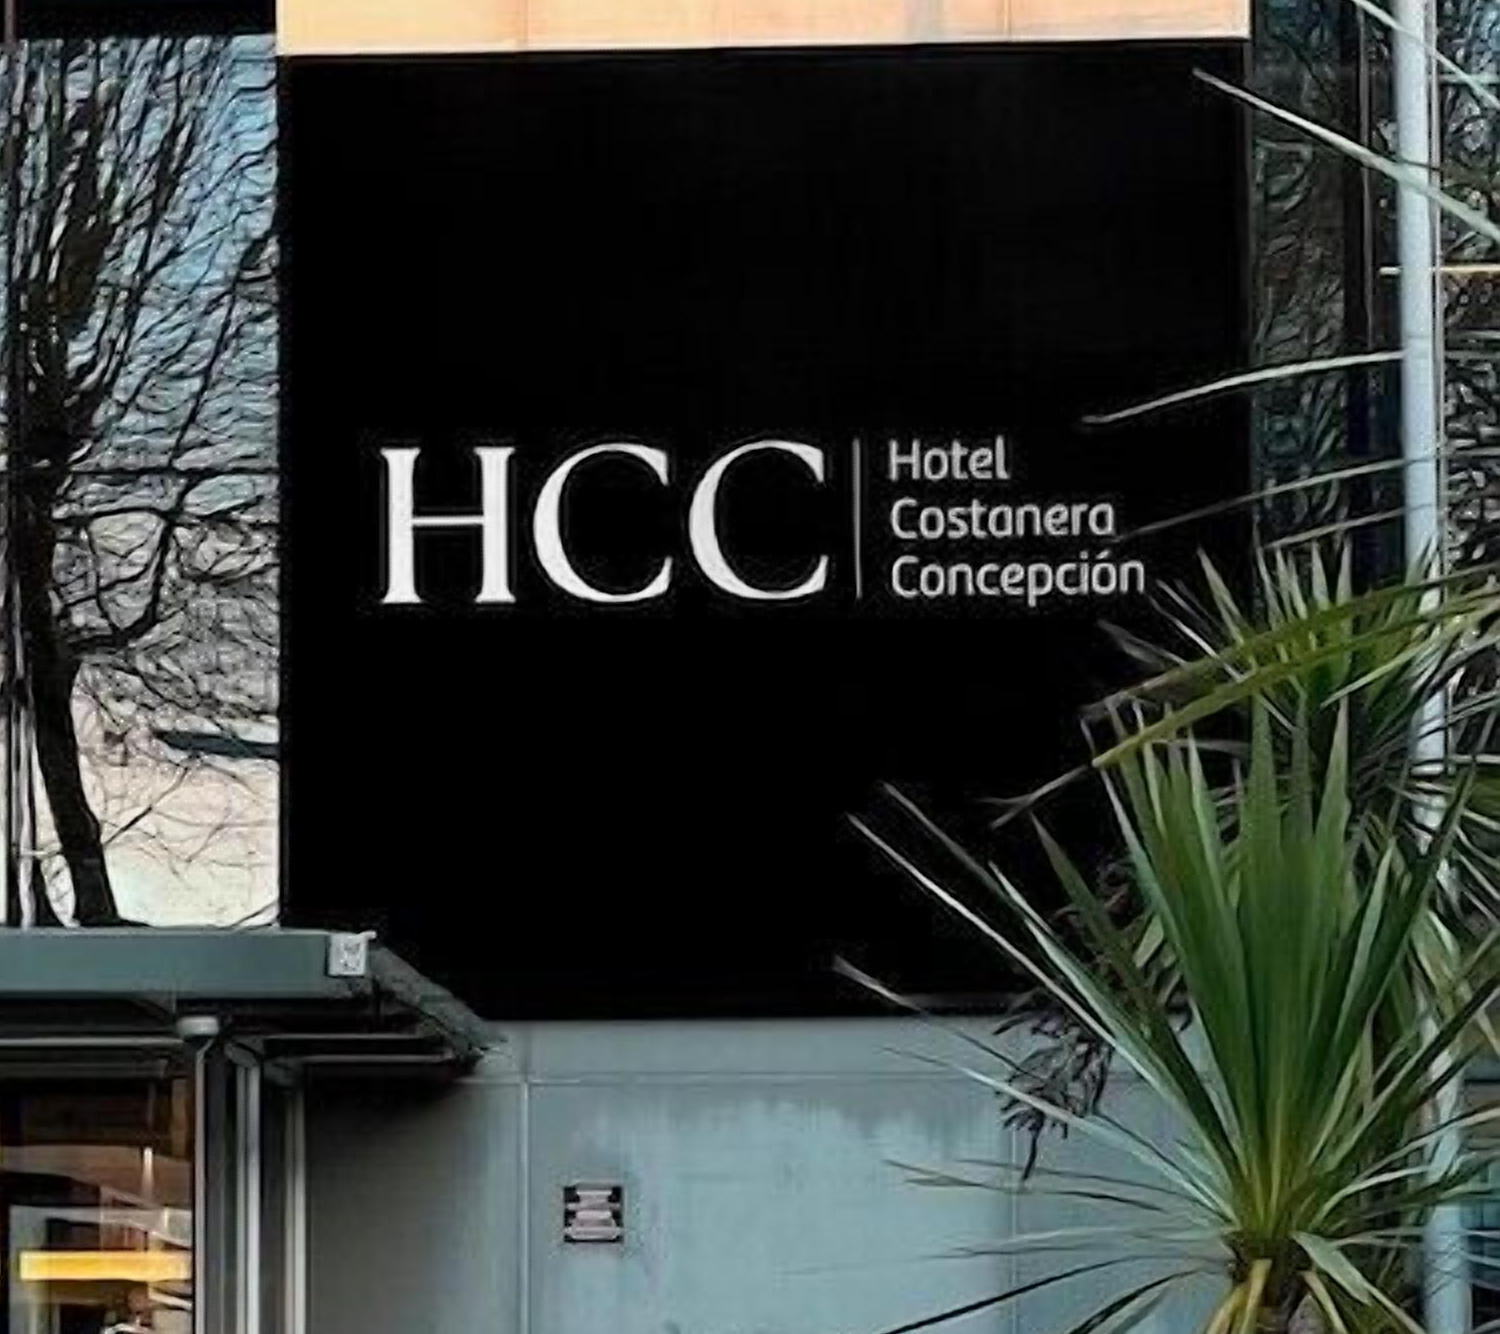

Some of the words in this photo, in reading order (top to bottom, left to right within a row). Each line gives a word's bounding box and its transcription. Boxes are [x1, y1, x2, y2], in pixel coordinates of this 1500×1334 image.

[889, 435, 1010, 481] Hotel
[380, 440, 829, 604] HCC
[890, 496, 1115, 540] Costanera
[891, 549, 1145, 608] Concepción
